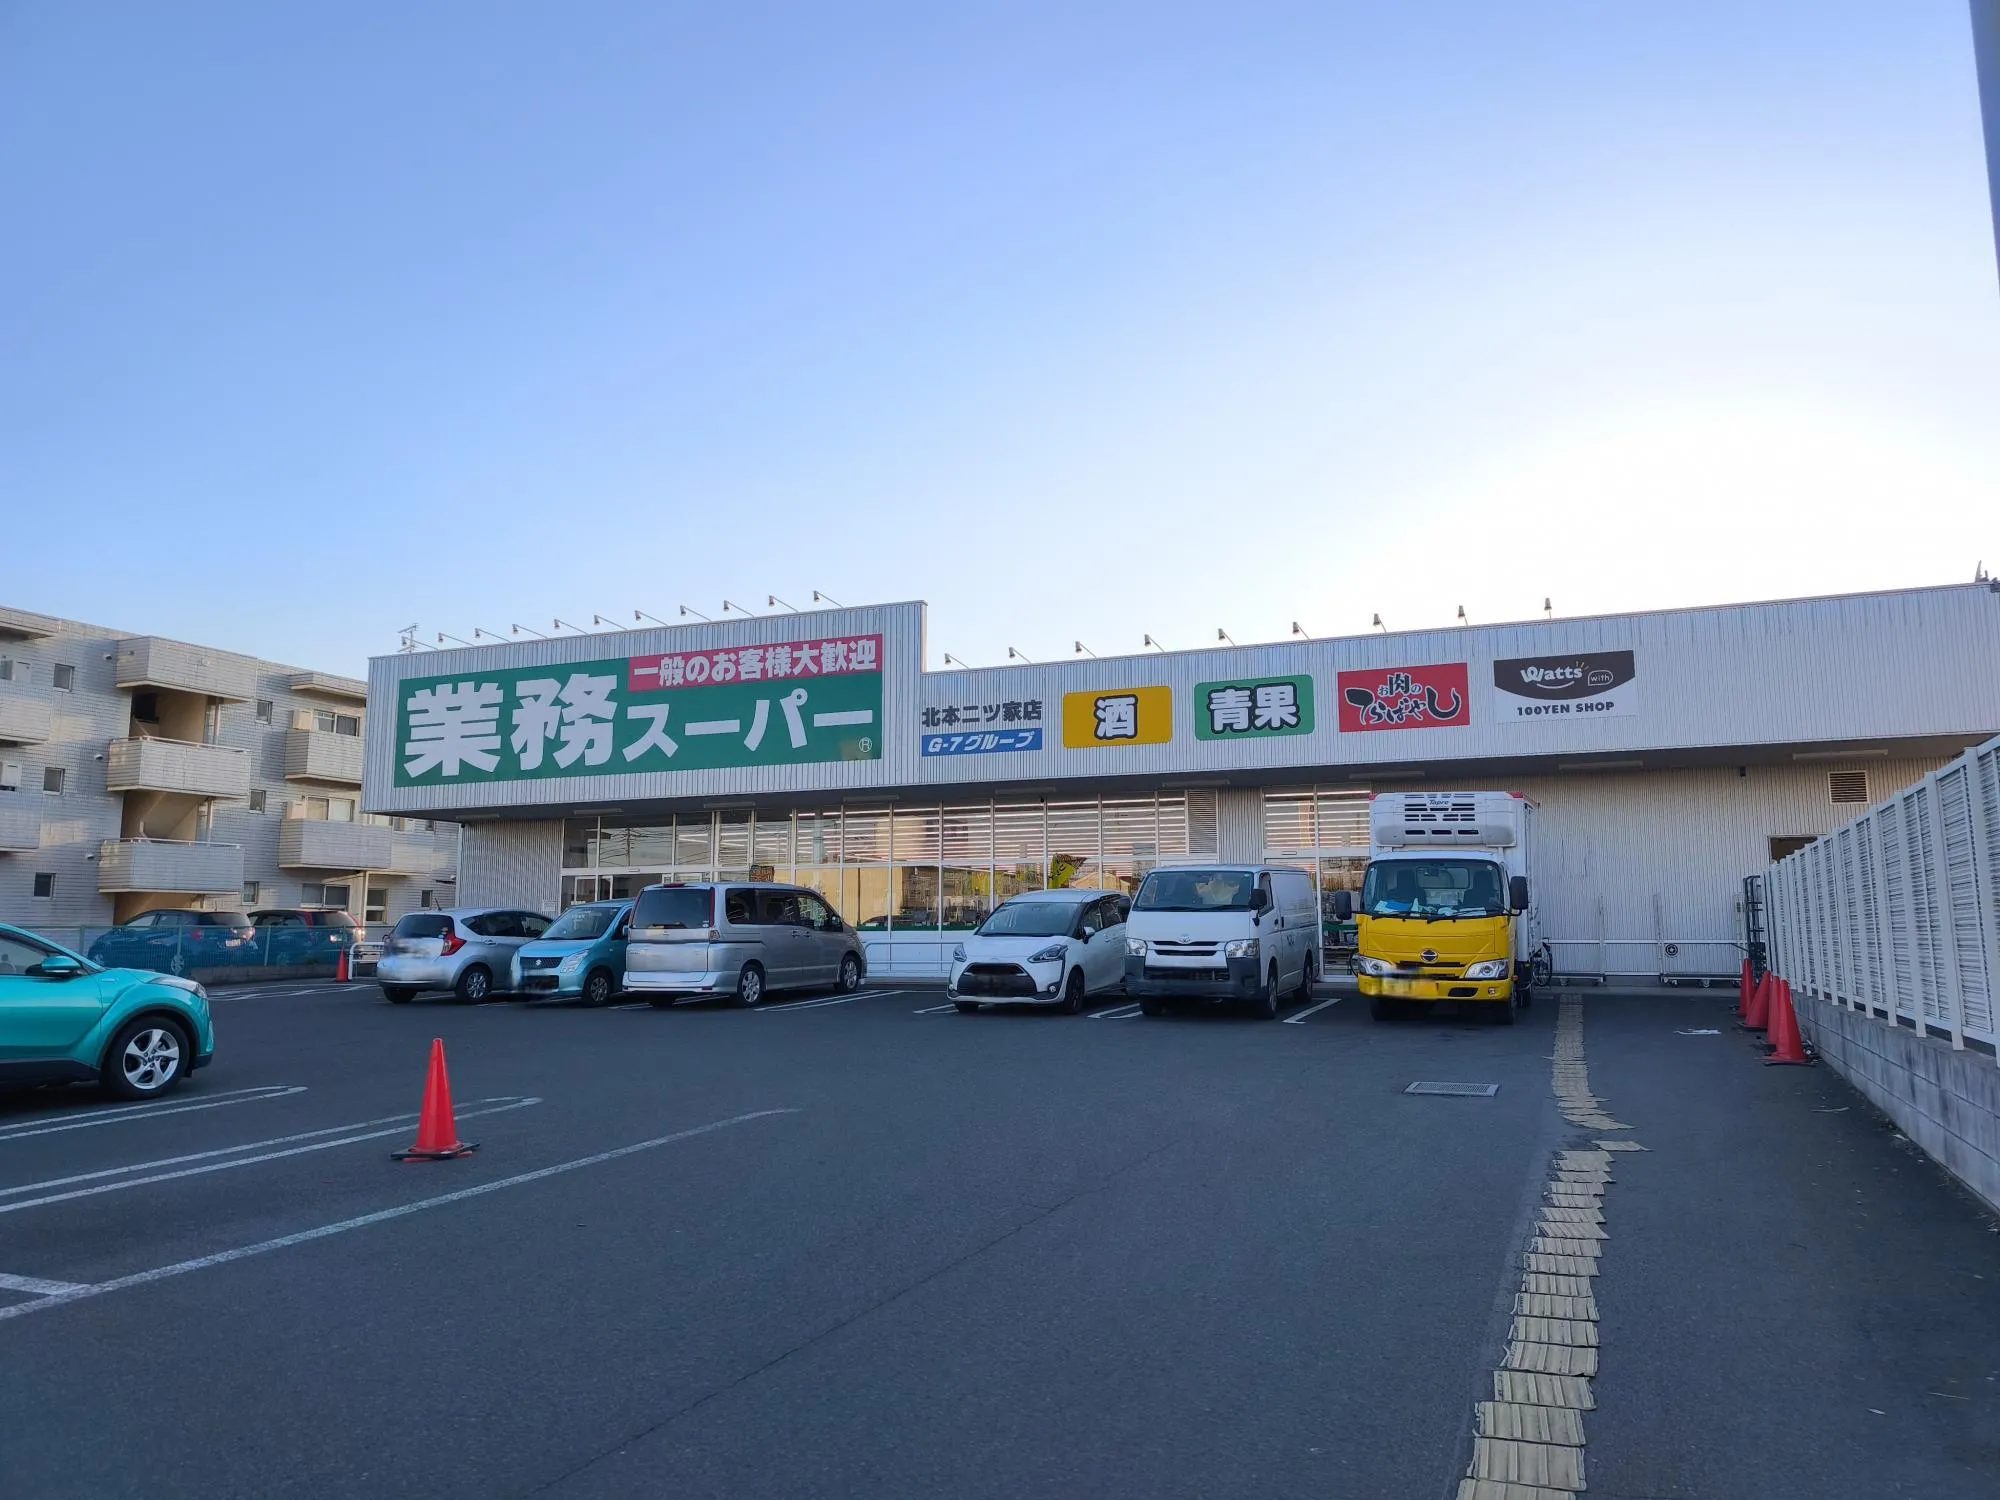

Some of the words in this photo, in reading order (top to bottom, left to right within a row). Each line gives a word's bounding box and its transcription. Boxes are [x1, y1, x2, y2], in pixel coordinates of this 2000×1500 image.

[634, 639, 877, 687] 一般のお客様大歓迎
[1520, 666, 1583, 683] Watts
[1590, 673, 1610, 682] with
[1378, 672, 1423, 697] お肉の
[404, 673, 873, 778] 業務スーパー
[921, 699, 1043, 728] 北本二ツ家店
[1094, 694, 1138, 740] 酒
[1207, 682, 1301, 734] 青果
[1517, 704, 1570, 716] 100YEN
[1576, 701, 1615, 713] SHOP
